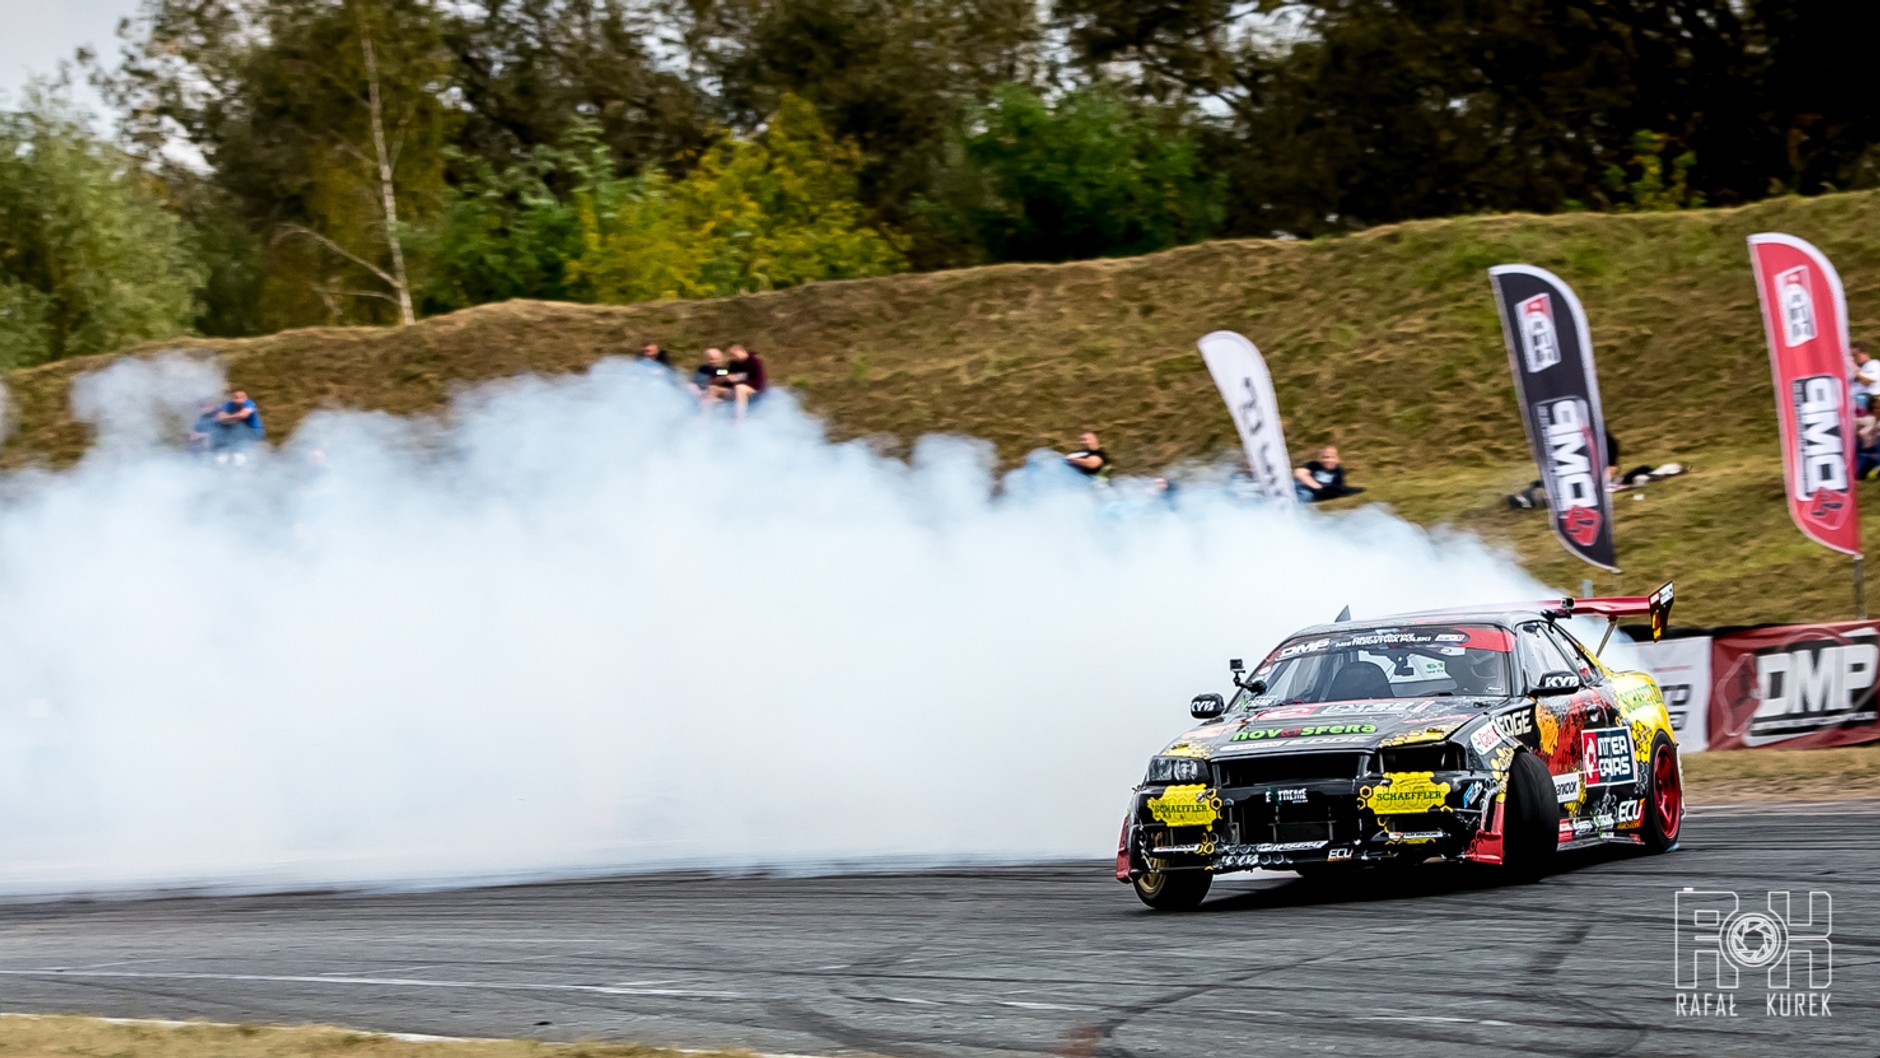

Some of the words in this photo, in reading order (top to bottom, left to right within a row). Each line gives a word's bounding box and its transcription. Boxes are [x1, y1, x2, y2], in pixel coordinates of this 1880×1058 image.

[1545, 676, 1579, 688] KYB
[1754, 643, 1878, 717] DMP
[1497, 709, 1533, 736] EDGE
[1598, 756, 1631, 777] CARS
[1377, 790, 1441, 801] SCHAEFFLER
[1153, 804, 1208, 814] SCHAEFFLER
[1618, 799, 1642, 822] ECU
[1328, 848, 1352, 859] ECU
